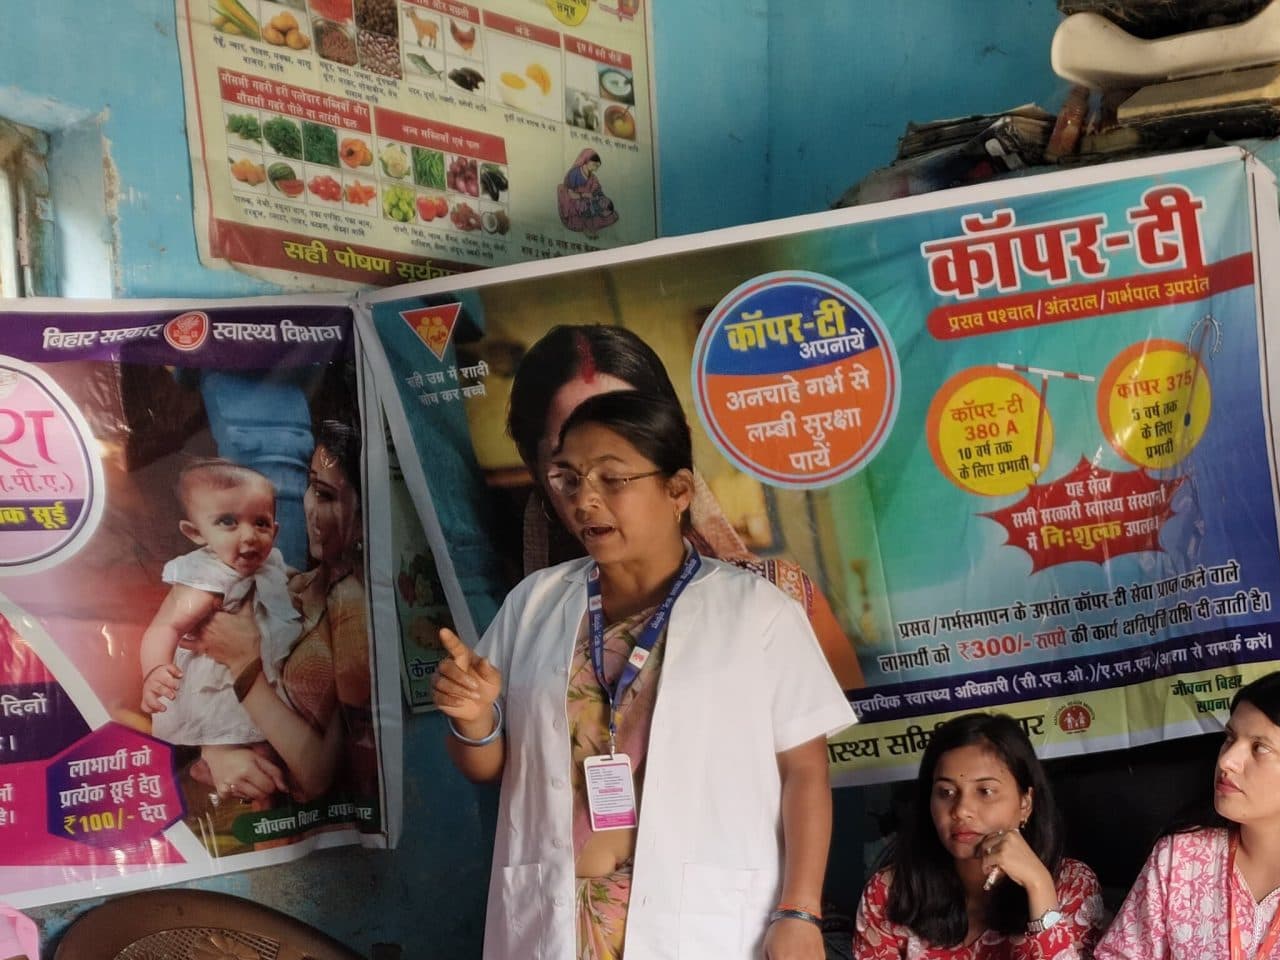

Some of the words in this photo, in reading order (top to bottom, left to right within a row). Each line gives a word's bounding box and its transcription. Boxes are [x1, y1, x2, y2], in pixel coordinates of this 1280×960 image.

[922, 184, 1203, 298] कॉपर-टी
[283, 239, 329, 264] सही
[333, 246, 391, 275] पोषण
[948, 312, 984, 332] प्रसव
[1165, 275, 1210, 299] उपरांत
[42, 327, 99, 348] बिहार
[100, 323, 163, 344] सरकार
[213, 321, 277, 342] स्वास्थ्य
[280, 319, 343, 343] विभाग
[725, 299, 847, 352] कॉपर-टी
[460, 360, 489, 380] शादी
[1166, 370, 1193, 392] 375
[726, 375, 801, 411] अनचाहे
[805, 367, 844, 397] गर्भ
[849, 363, 870, 391] से
[951, 393, 1025, 424] कॉपर-टी
[1144, 402, 1160, 420] वर्ष
[1163, 399, 1179, 414] तक
[746, 411, 797, 442] लम्बी
[801, 408, 861, 442] सुरक्षा
[964, 424, 1000, 442] 380
[1005, 419, 1019, 436] A
[1141, 423, 1154, 441] के
[1154, 419, 1174, 438] लिए
[789, 442, 831, 471] पायें
[958, 447, 972, 461] 10
[975, 442, 992, 459] वर्ष
[995, 440, 1013, 454] तक
[959, 464, 970, 481] के
[972, 460, 995, 479] लिए
[997, 455, 1030, 477] प्रभावी
[1065, 479, 1085, 497] यह
[1088, 475, 1113, 495] सेवा
[1012, 508, 1037, 528] सभी
[1039, 501, 1081, 524] सरकारी
[1085, 496, 1124, 519] स्वास्थ्य
[1026, 532, 1039, 551] में
[1012, 602, 1027, 621] के
[1130, 581, 1154, 602] सेवा
[1180, 566, 1207, 591] करने
[1209, 559, 1241, 585] वाले
[879, 649, 930, 674] लाभार्थी
[931, 643, 951, 665] को
[1070, 625, 1089, 646] की
[1197, 600, 1212, 620] दी
[1213, 593, 1248, 617] जाती
[851, 694, 901, 717] मुदायिक
[903, 688, 951, 707] स्वास्थ्य
[954, 677, 1009, 699] अधिकारी
[827, 738, 879, 764] ास्थ्य
[884, 722, 945, 757] समि
[68, 747, 128, 779] लाभार्थी
[130, 744, 153, 767] को
[59, 783, 106, 809] प्रत्येक
[138, 803, 168, 823] देय
